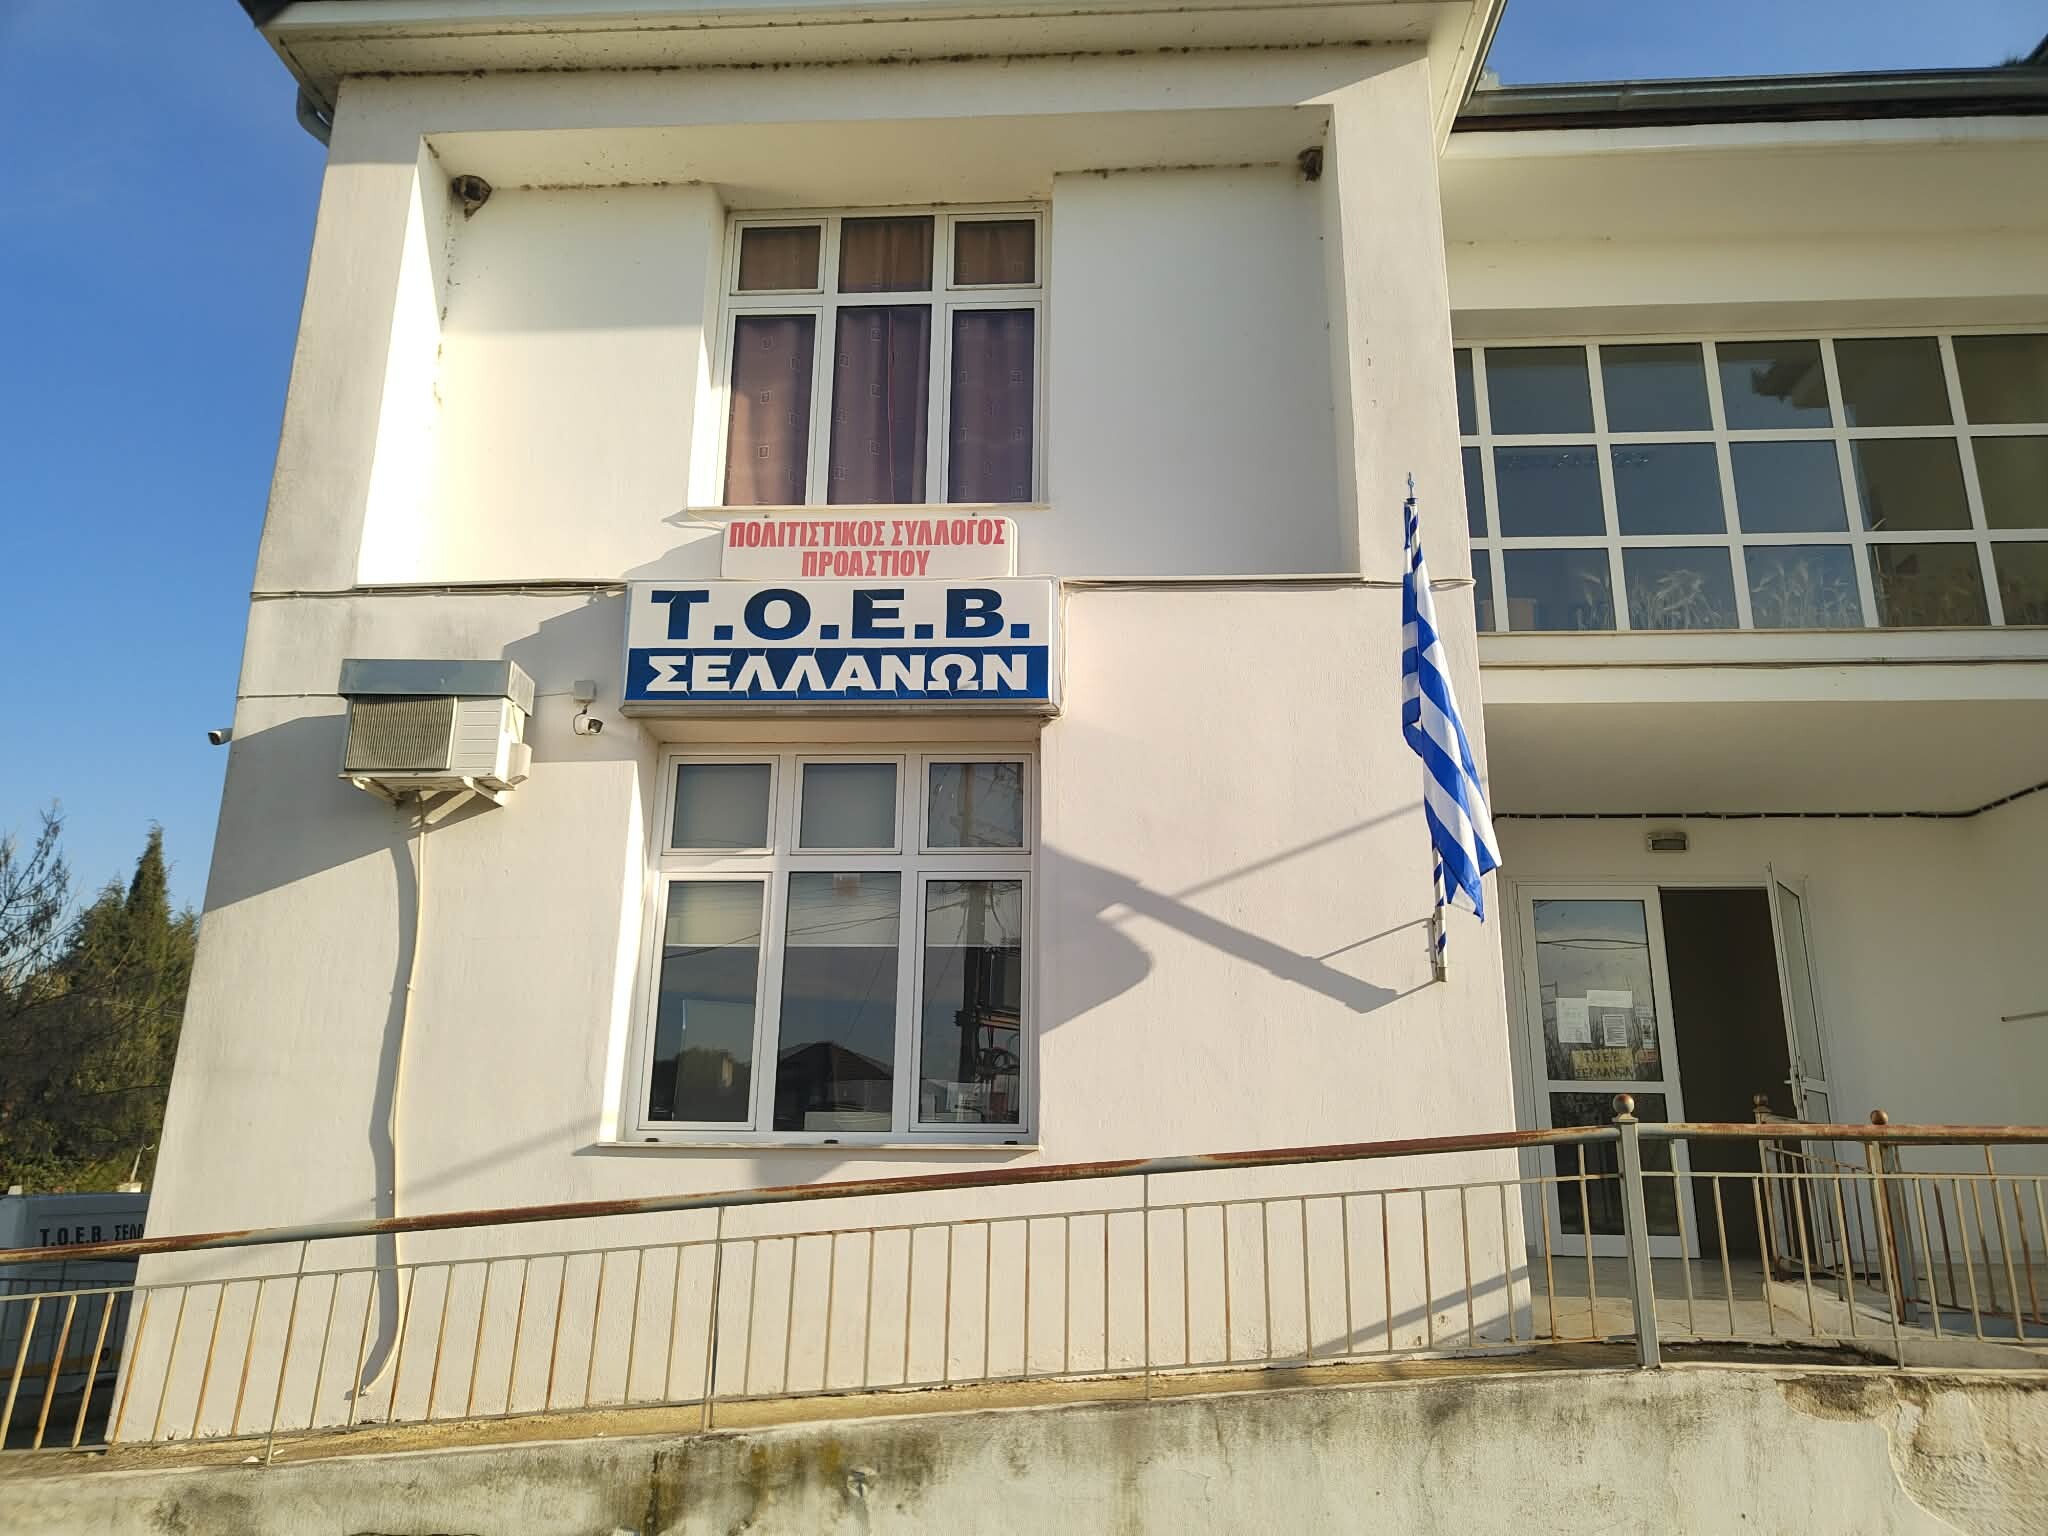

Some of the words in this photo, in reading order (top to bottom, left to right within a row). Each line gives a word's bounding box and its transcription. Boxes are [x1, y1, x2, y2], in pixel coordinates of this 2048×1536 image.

[729, 520, 885, 548] ΠΟΛΙΤΙΣΤΙΚΟΣ
[891, 518, 1006, 546] ΣΥΛΛΟΓΟΣ
[801, 549, 931, 577] ΠΡΟΑΣΤΙΟΥ
[652, 588, 1031, 641] Τ.Ο.Ε.Β.
[646, 653, 1030, 693] ΣΕΛΛΑΝΩΝ
